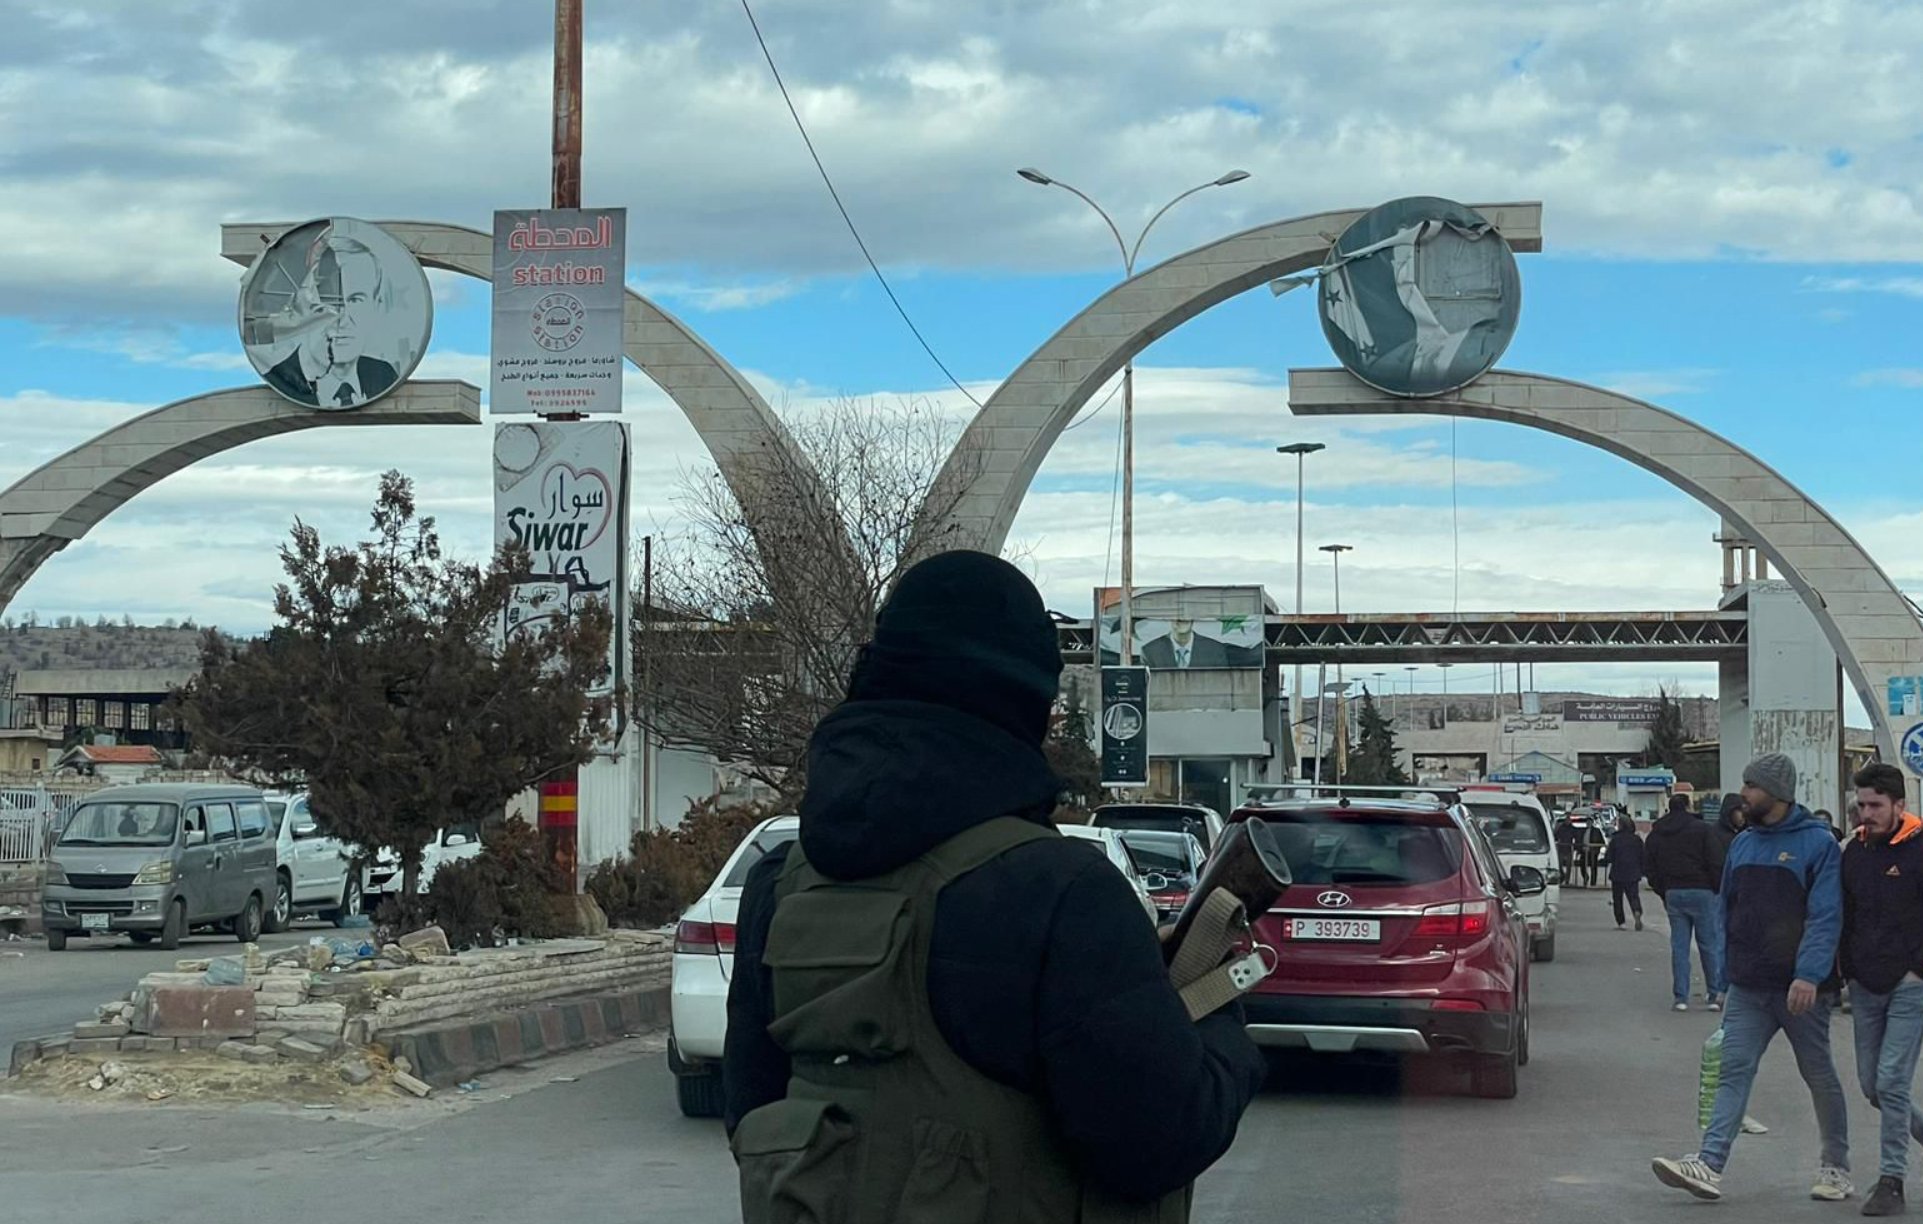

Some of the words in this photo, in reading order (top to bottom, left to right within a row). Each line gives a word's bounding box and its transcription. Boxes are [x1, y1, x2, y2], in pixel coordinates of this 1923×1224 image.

[508, 215, 612, 251] المحطة
[512, 261, 605, 285] station
[507, 506, 588, 552] Siwar
[1296, 922, 1305, 936] P
[1314, 921, 1370, 937] 393739
